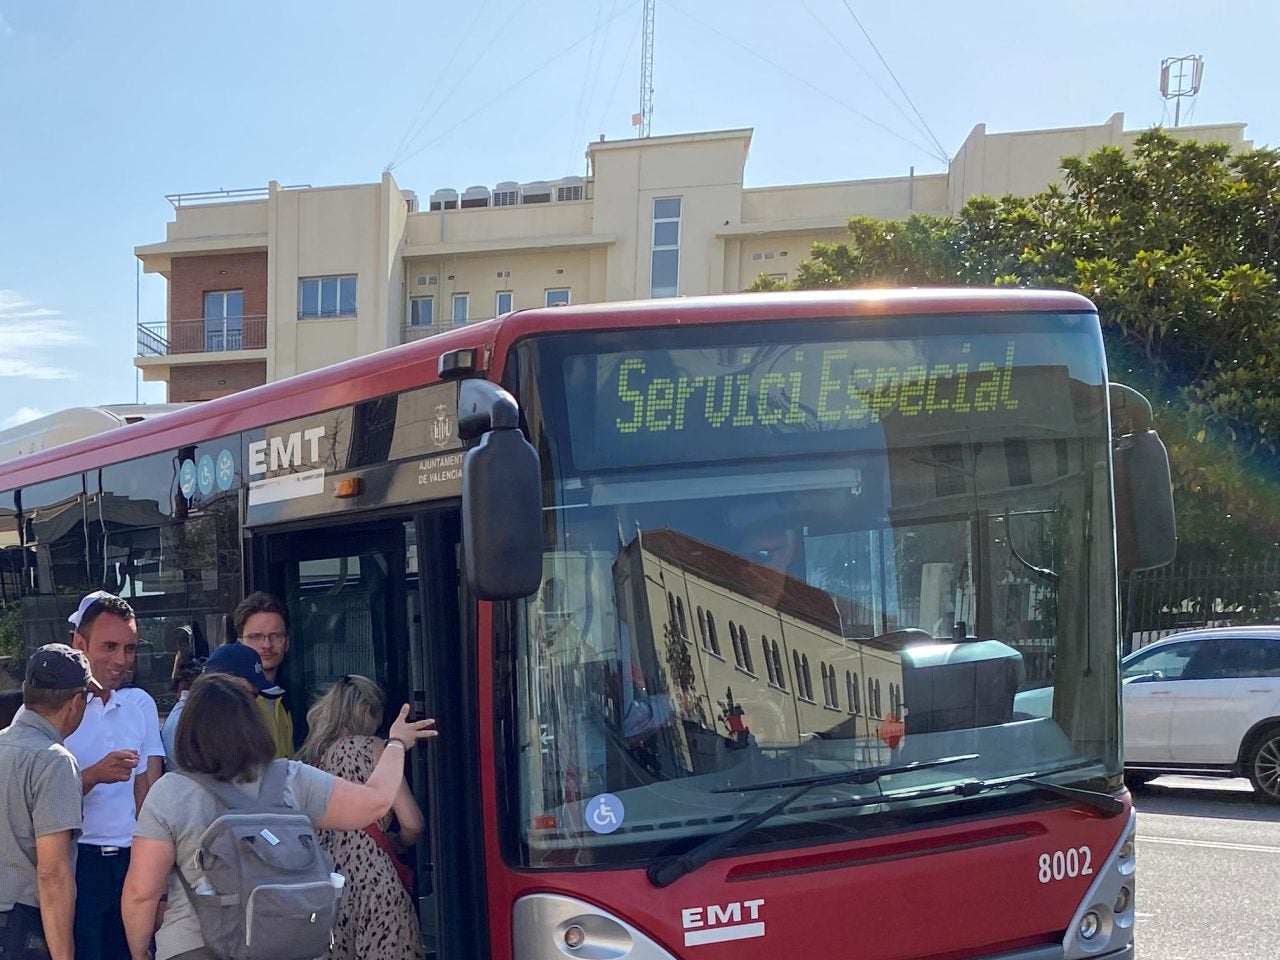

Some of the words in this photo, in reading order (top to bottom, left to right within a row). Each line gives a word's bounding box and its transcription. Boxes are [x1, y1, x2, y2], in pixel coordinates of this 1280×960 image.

[615, 351, 807, 434] Servici
[816, 339, 1020, 424] Especial
[249, 425, 326, 476] EMT
[419, 454, 463, 471] AJUNTAMENT
[418, 474, 428, 485] DE
[429, 469, 463, 483] VALENCIA
[1038, 845, 1093, 884] 8002
[681, 898, 765, 929] EMT
